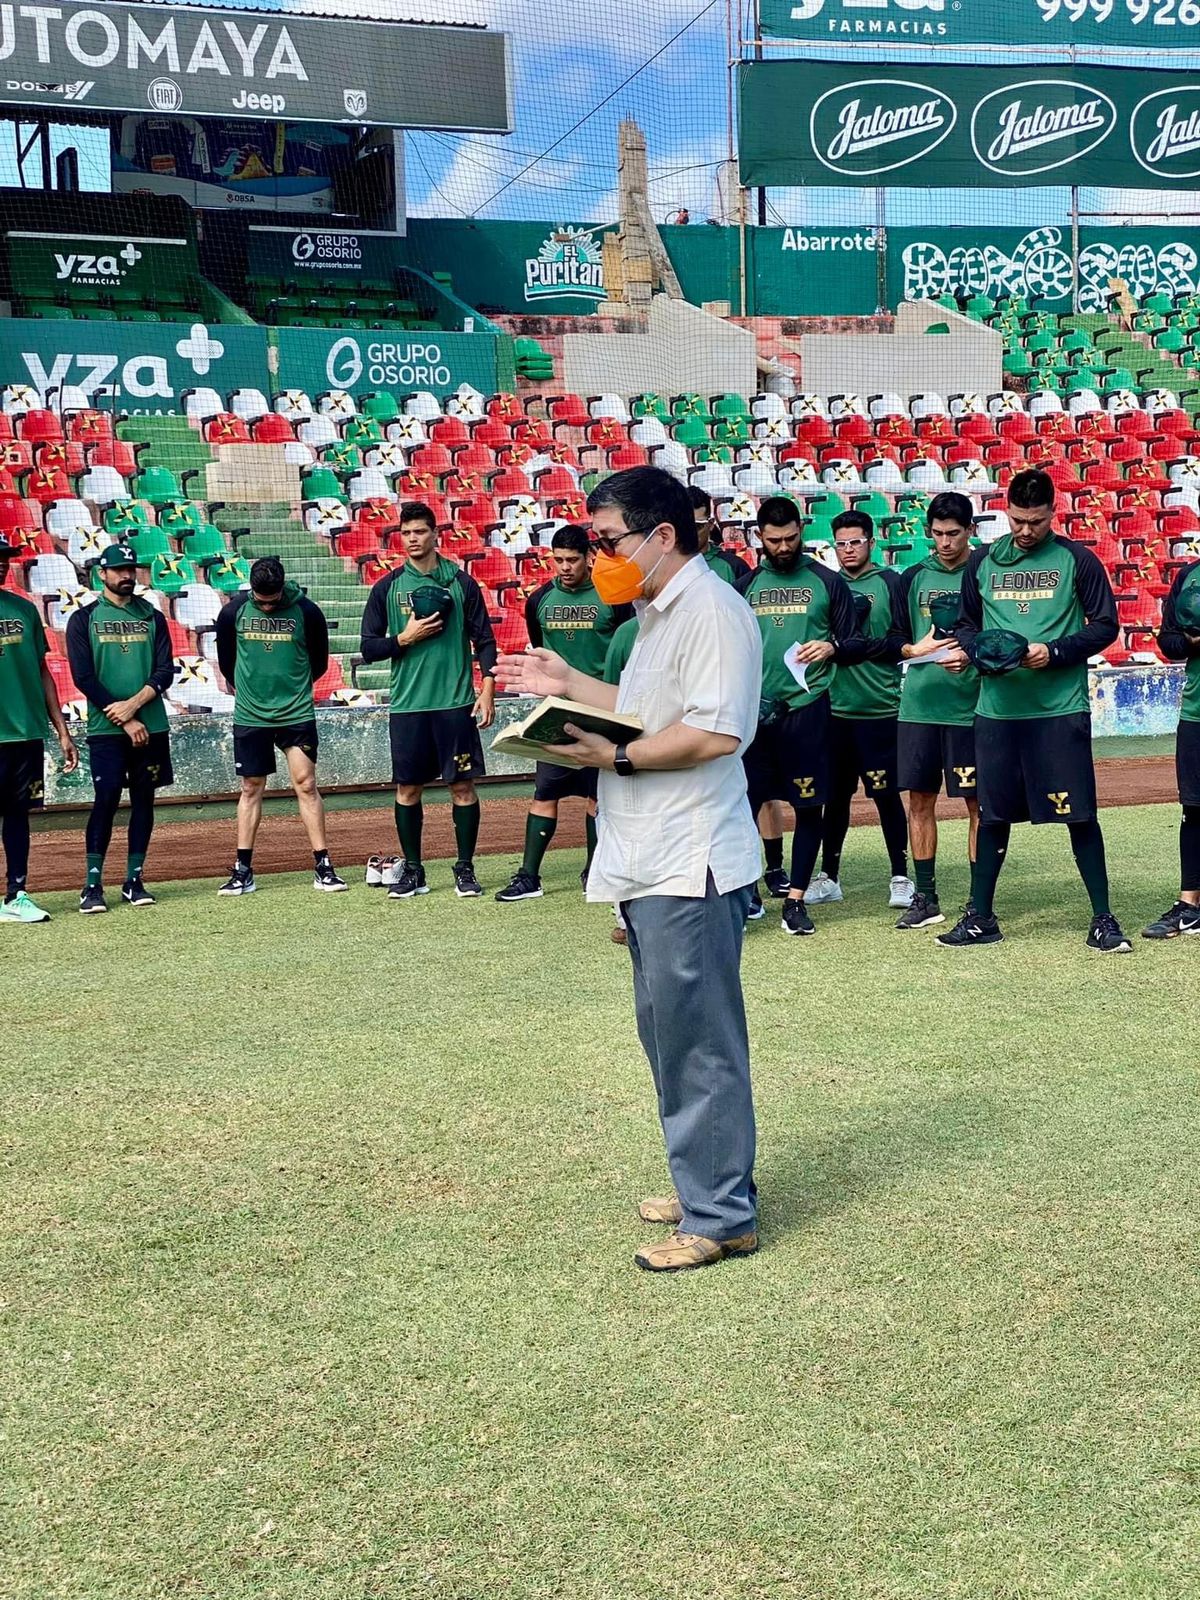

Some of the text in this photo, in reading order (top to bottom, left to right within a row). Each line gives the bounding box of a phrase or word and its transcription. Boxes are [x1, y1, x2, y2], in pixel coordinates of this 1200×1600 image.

[1036, 0, 1114, 23] 999
[828, 19, 948, 35] FARMACIAS
[155, 86, 176, 104] FIAT
[232, 89, 286, 113] Jeep
[827, 97, 945, 161] Jaloma
[987, 97, 1105, 161] Jaloma
[316, 234, 358, 247] GRUPO
[317, 246, 362, 259] OSORIO
[564, 245, 579, 257] EL
[54, 253, 120, 279] yza
[526, 257, 603, 287] Puritan
[71, 276, 121, 285] FARMACIAS
[367, 342, 442, 365] GRUPO
[368, 363, 451, 386] OSORIO
[118, 547, 134, 560] Y
[990, 570, 1060, 590] LEONES
[749, 587, 813, 607] LEONES
[997, 591, 1049, 600] BASEBALL
[544, 605, 599, 620] LEONES
[1016, 602, 1029, 615] Y
[93, 620, 149, 635] LEONES
[241, 616, 297, 634] LEONES
[771, 616, 784, 628] Y
[565, 630, 575, 640] Y
[263, 642, 274, 652] Y
[793, 776, 815, 799] Y
[865, 769, 887, 790] Y
[1047, 791, 1071, 815] Y
